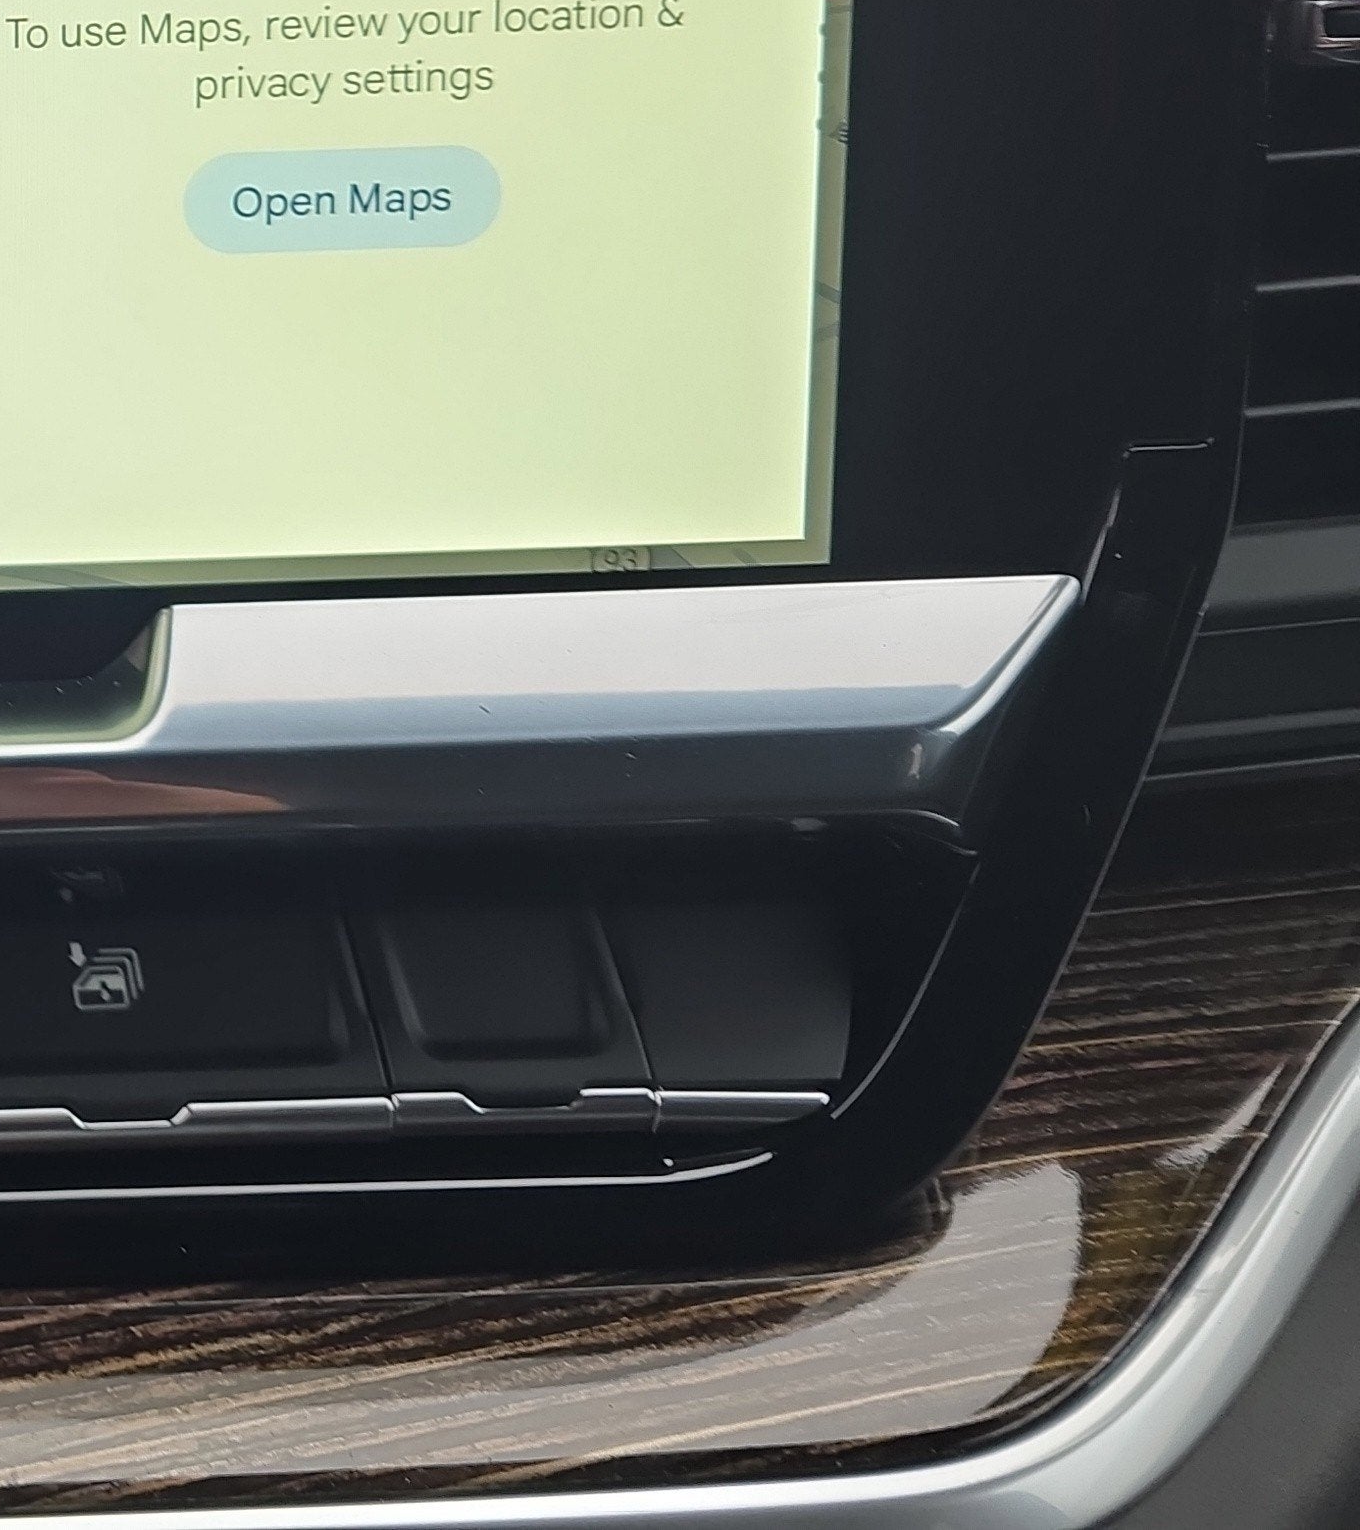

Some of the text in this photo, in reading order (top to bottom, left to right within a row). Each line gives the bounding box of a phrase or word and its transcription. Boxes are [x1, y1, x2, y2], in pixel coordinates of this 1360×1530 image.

[5, 16, 49, 50] To
[61, 21, 127, 49] use
[141, 12, 251, 52] Maps,
[266, 5, 388, 41] review
[397, 9, 482, 45] your
[196, 59, 494, 109] privacy settings
[233, 182, 451, 226] Open Maps
